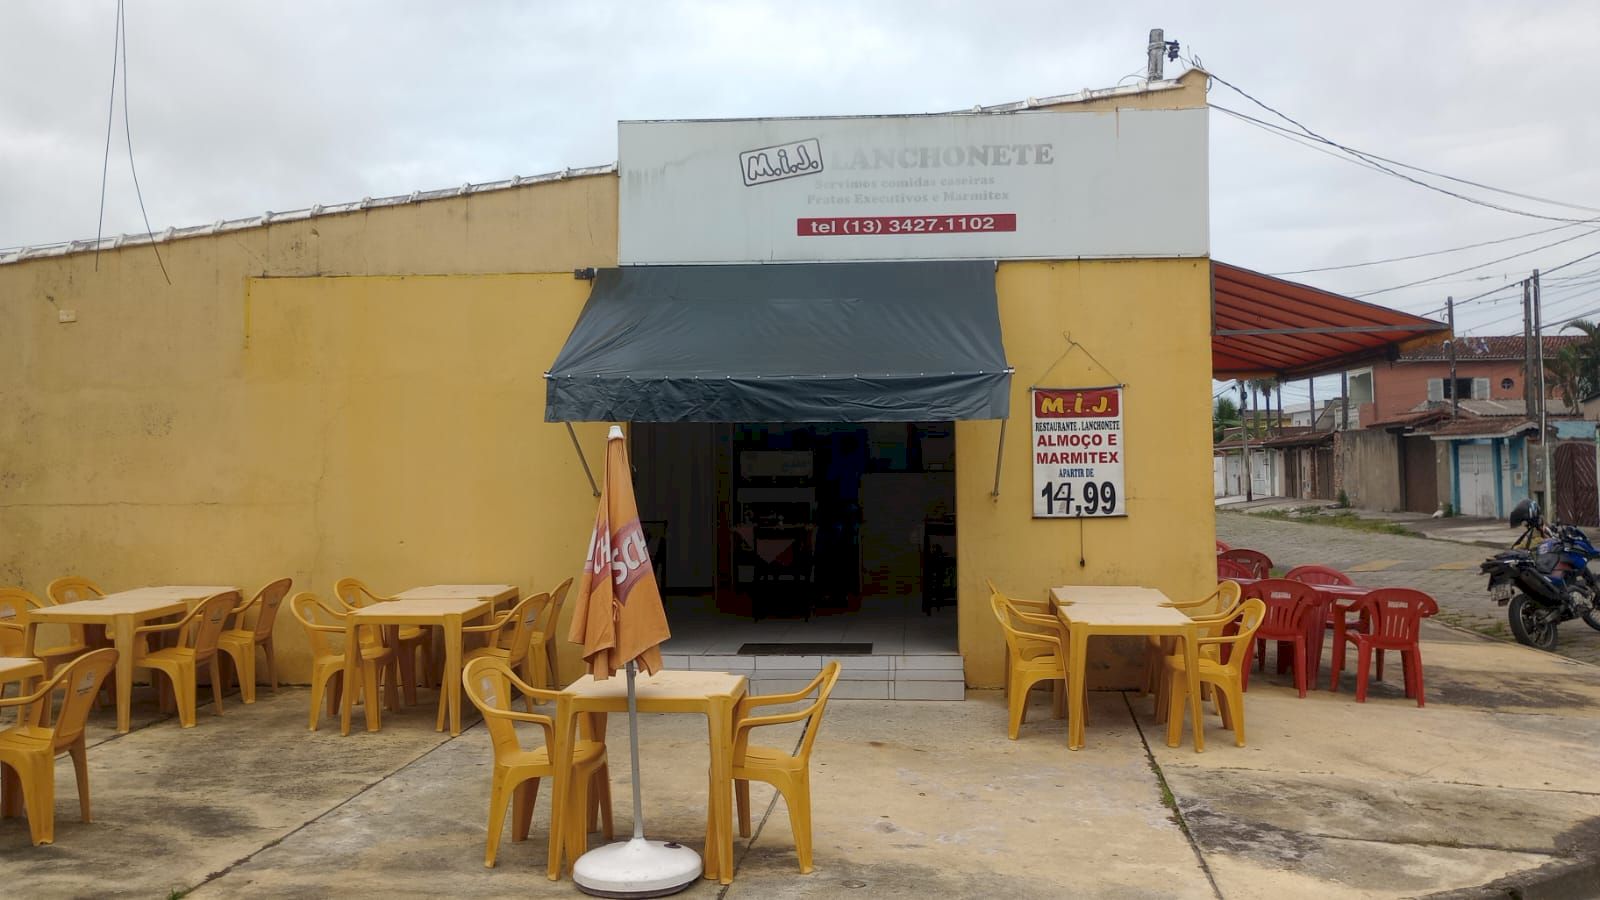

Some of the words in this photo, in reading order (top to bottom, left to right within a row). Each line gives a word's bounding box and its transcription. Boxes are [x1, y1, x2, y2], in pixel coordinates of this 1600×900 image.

[831, 143, 1054, 171] LANCHONETE
[940, 175, 996, 187] caseiras
[943, 190, 1009, 203] Marmitex
[810, 220, 836, 233] tel
[843, 219, 882, 234] (13)
[888, 217, 995, 232] 3427.1102
[1035, 421, 1077, 432] RESTAURANTE
[1081, 420, 1120, 431] LANCHONETE
[1037, 434, 1103, 449] ALMOÇO
[1108, 434, 1117, 446] E
[1036, 451, 1119, 465] MARMITEX
[1041, 481, 1116, 516] 14,99
